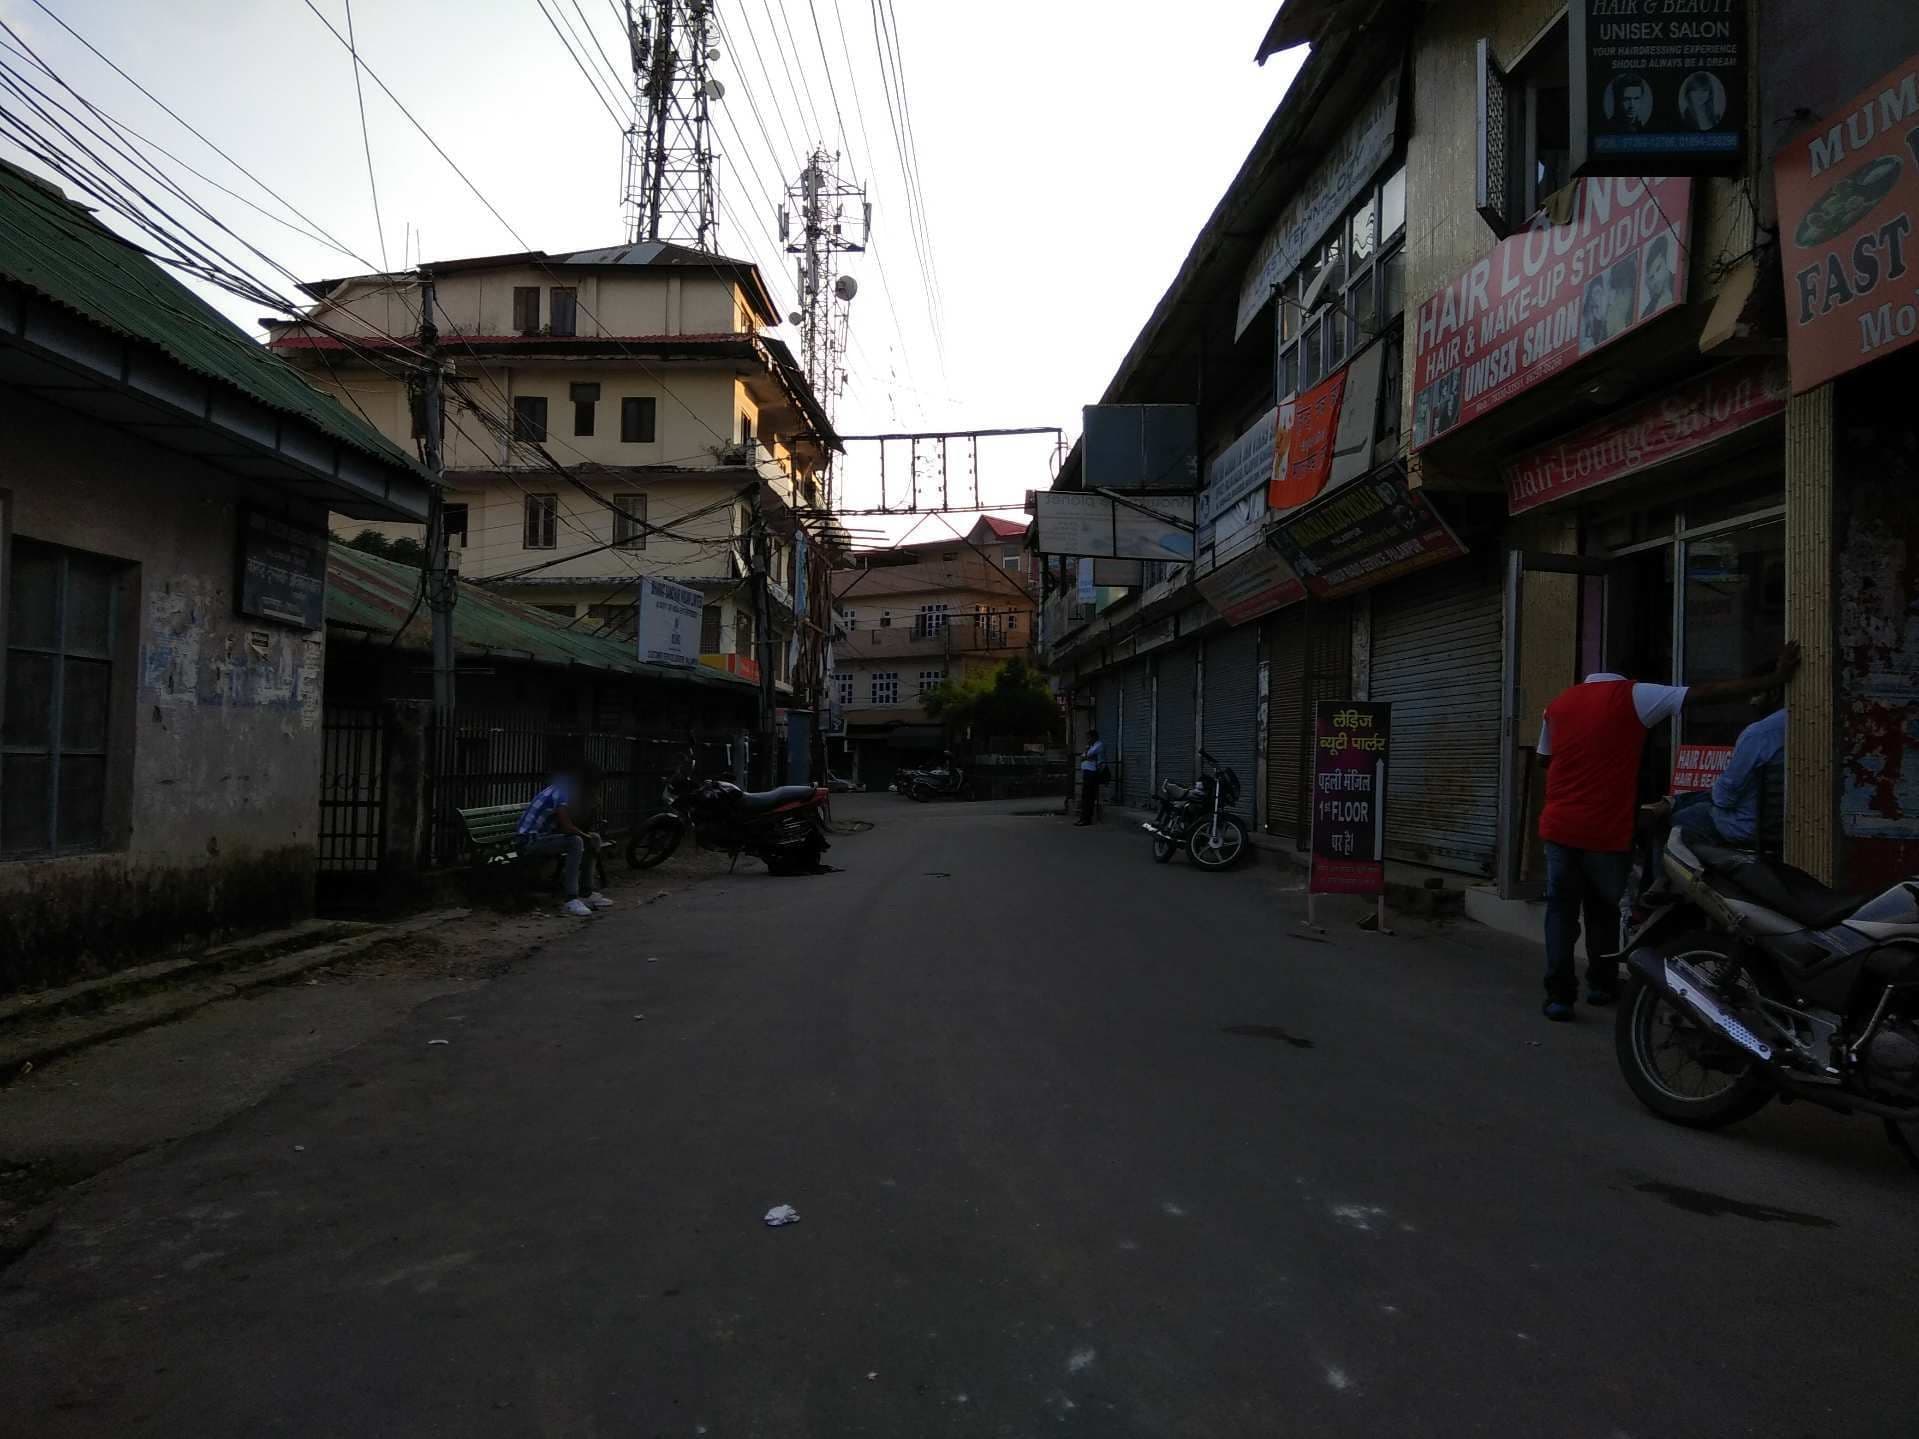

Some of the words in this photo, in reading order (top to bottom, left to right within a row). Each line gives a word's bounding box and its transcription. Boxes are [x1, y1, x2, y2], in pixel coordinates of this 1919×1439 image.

[1592, 0, 1638, 15] HAIR
[1600, 22, 1664, 40] UNISEX
[1669, 20, 1730, 39] SALON
[1592, 47, 1616, 56] YOUR
[1683, 43, 1737, 54] EXPERIENCE
[1612, 59, 1647, 69] SHOULD
[1648, 57, 1682, 68] ALWAYS
[1684, 57, 1697, 67] BE
[1418, 257, 1490, 357] HAIR
[1500, 177, 1666, 297] LOUN
[1797, 214, 1911, 326] FAST
[1425, 335, 1461, 384] HAIR
[1464, 327, 1476, 358] &
[1480, 262, 1566, 350] MAKE-UP
[1571, 203, 1660, 287] STUDIO
[1464, 340, 1518, 402] UNISEX
[1523, 296, 1581, 369] SALON
[1510, 460, 1553, 502] Hair
[1561, 428, 1651, 483] Lounge
[1662, 376, 1752, 442] Salon
[1351, 732, 1386, 752] पार्लर
[1680, 750, 1699, 770] HAIR
[1701, 750, 1733, 771] LOUNG
[1318, 768, 1343, 794] पहली
[1331, 800, 1369, 822] FLOOR
